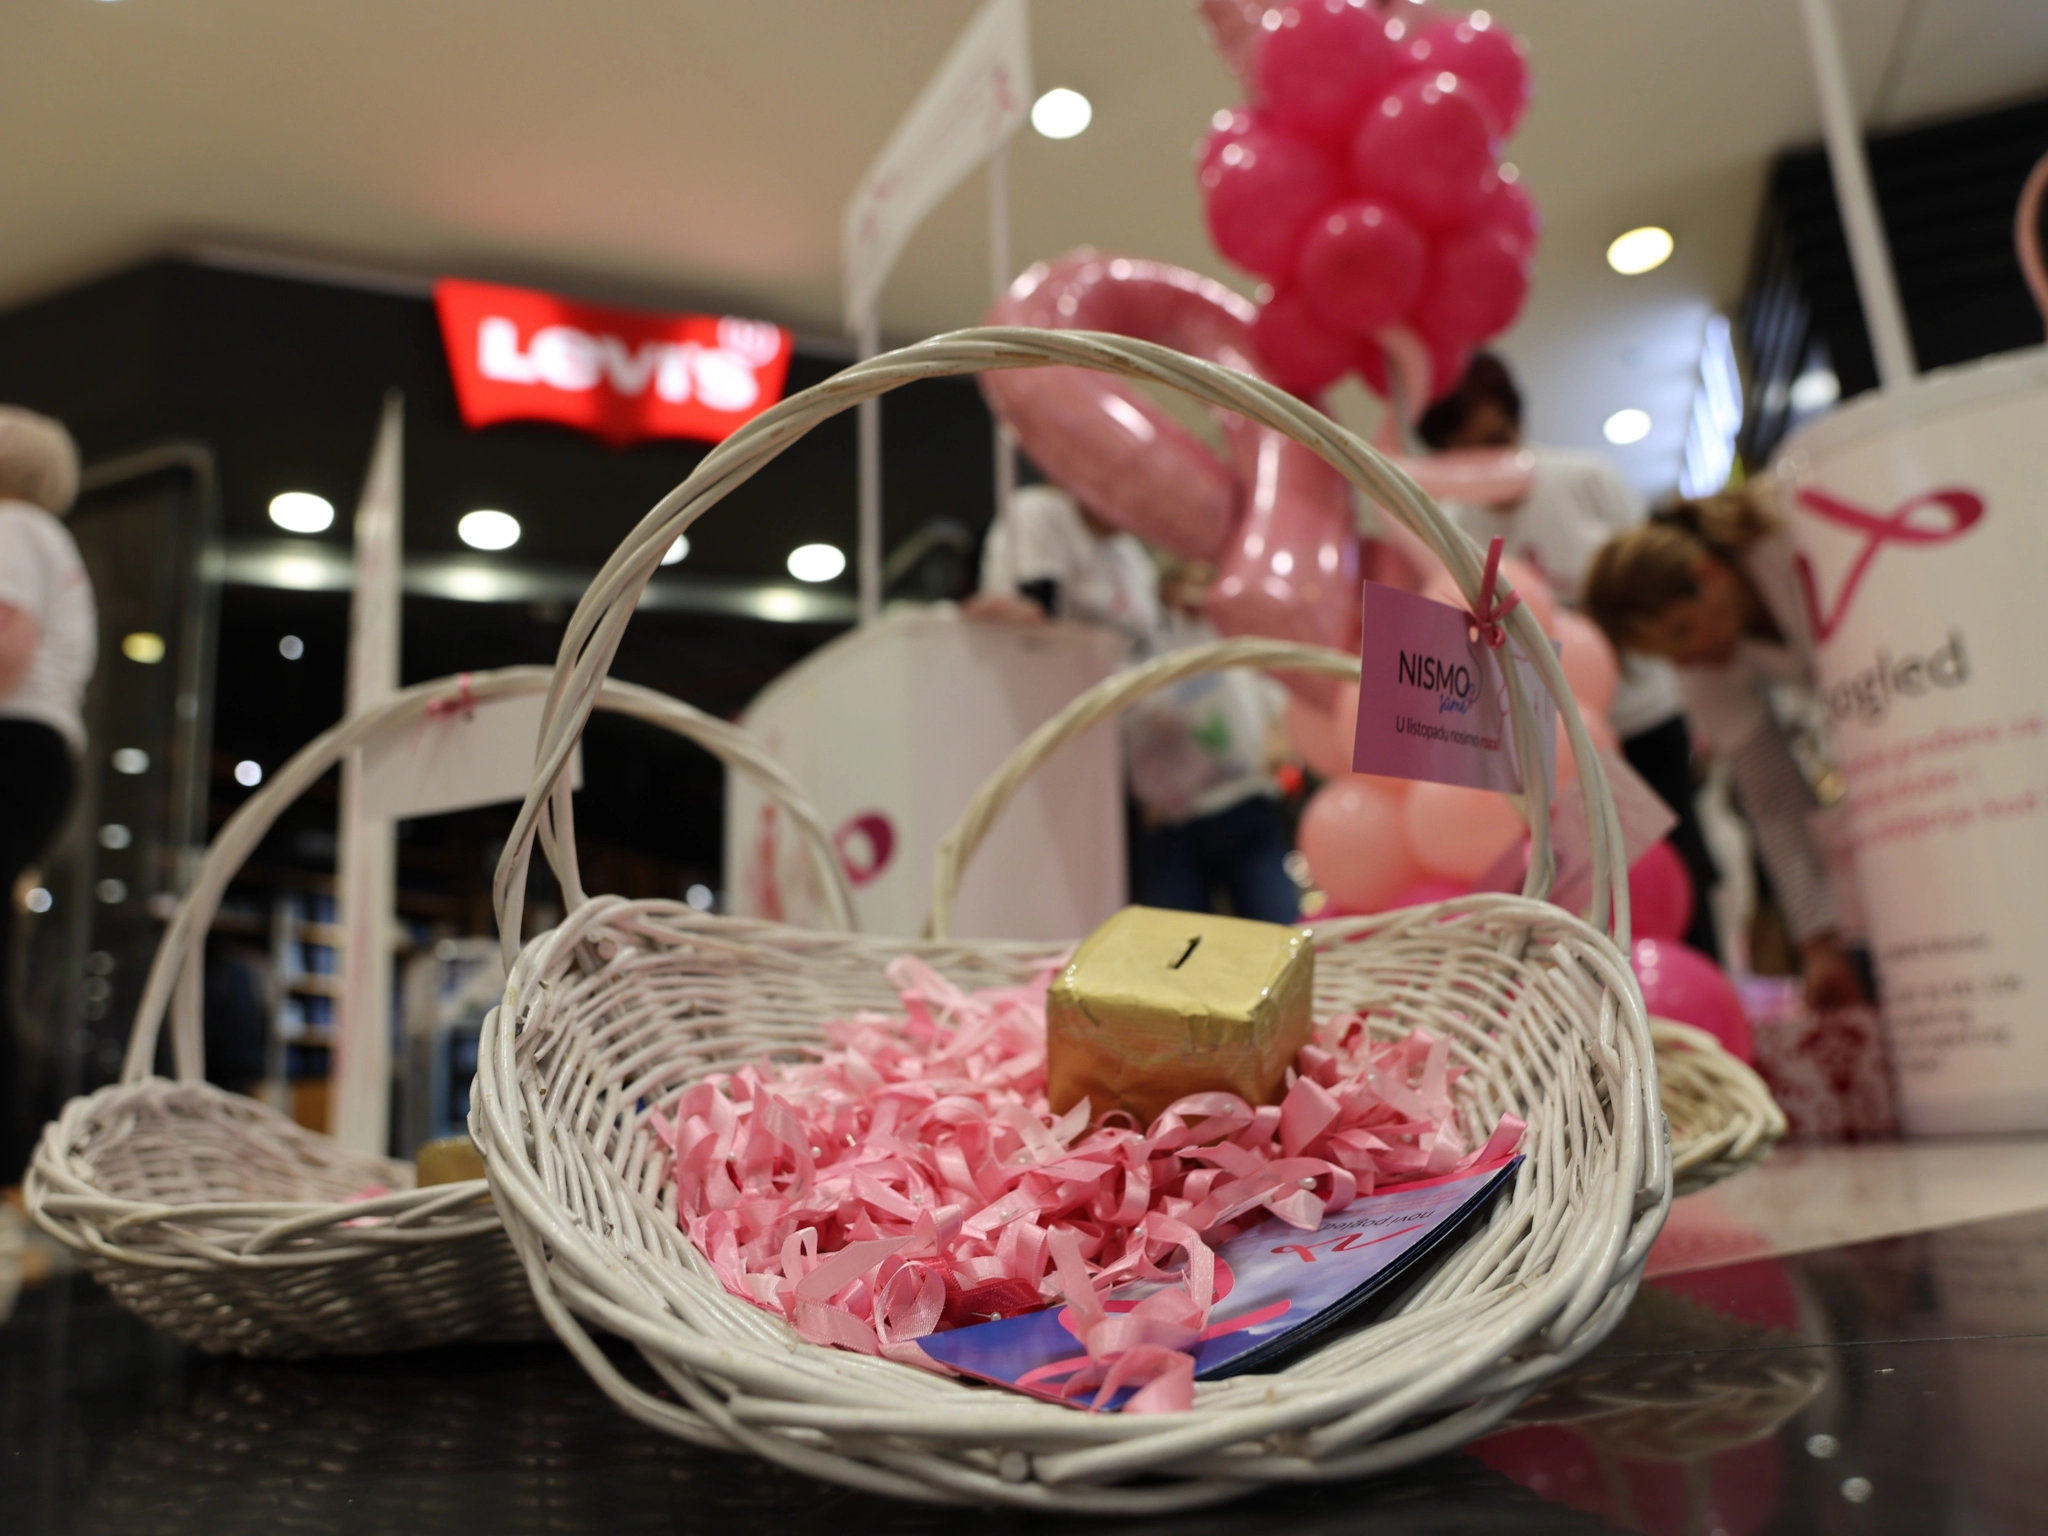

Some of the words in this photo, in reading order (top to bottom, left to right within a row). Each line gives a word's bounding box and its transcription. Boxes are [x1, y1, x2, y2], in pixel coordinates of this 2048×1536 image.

[1398, 649, 1470, 699] NISMO
[1396, 715, 1406, 734] U
[1166, 934, 1202, 971] 1
[1387, 1210, 1436, 1228] novi
